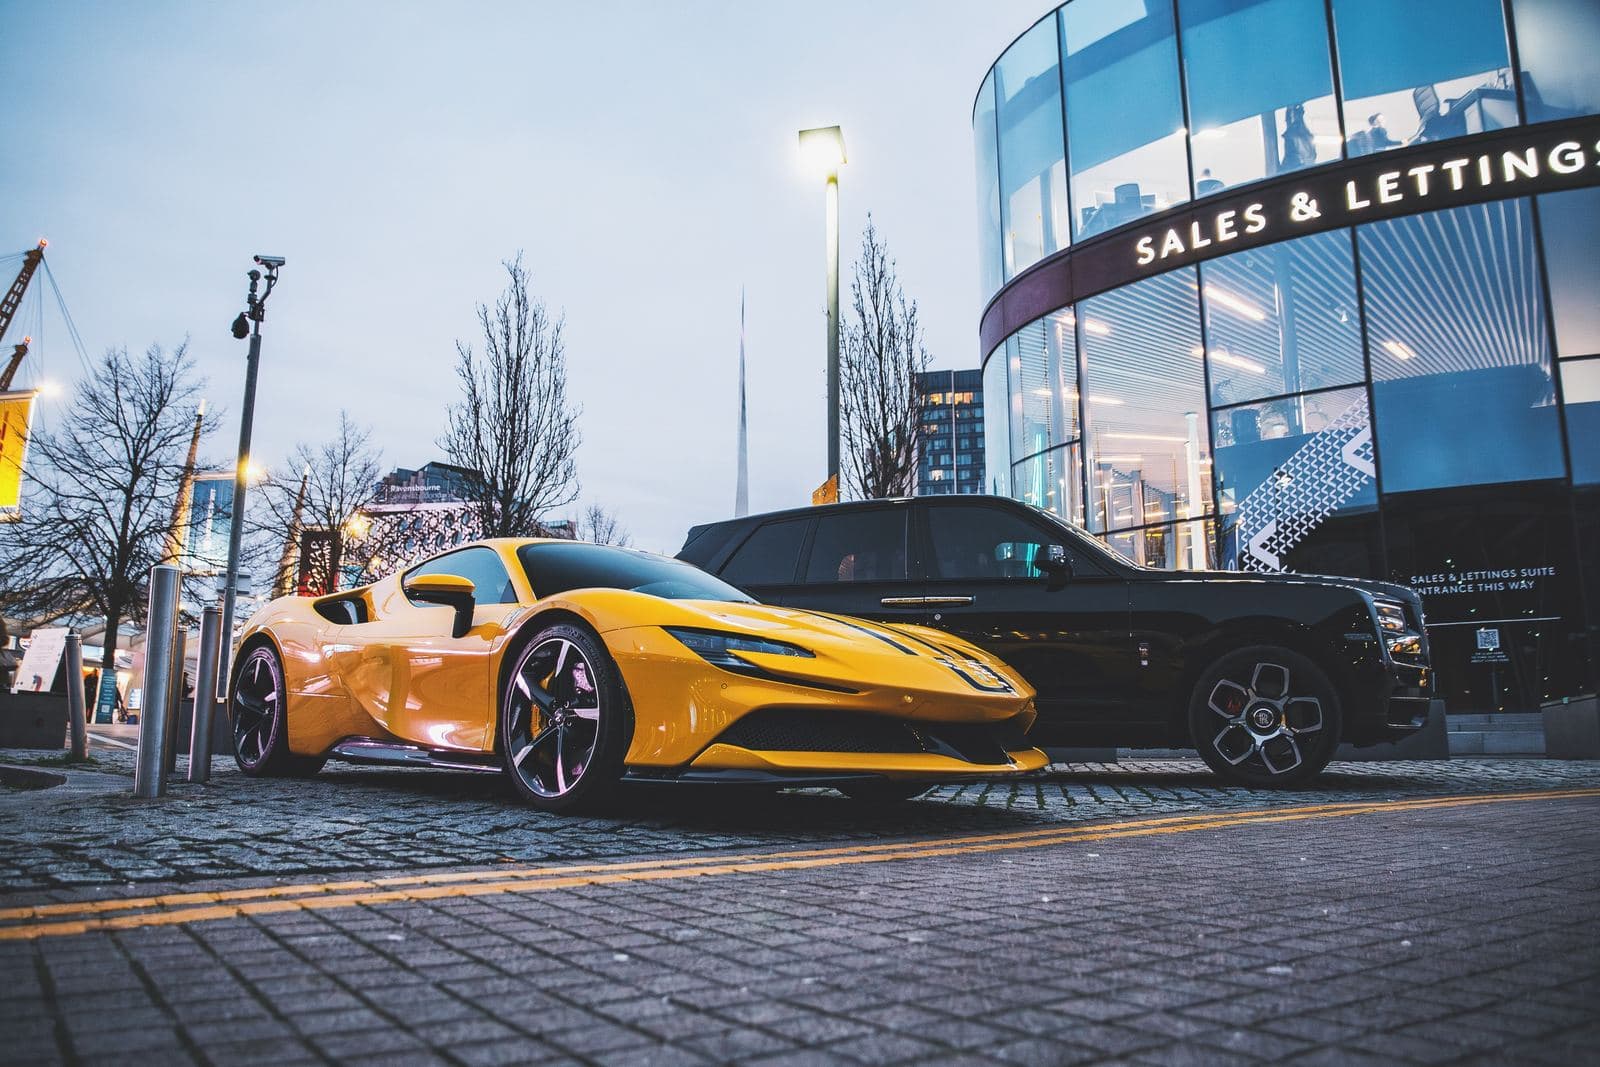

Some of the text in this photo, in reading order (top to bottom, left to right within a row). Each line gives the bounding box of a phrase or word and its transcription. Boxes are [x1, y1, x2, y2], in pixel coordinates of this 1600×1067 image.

[1136, 141, 1600, 265] SALES & LETTING
[390, 484, 440, 492] Ravensbourne
[1411, 567, 1556, 584] SALES & LETTINGS SUITE
[1478, 582, 1504, 592] THIS
[1508, 580, 1535, 591] WAY
